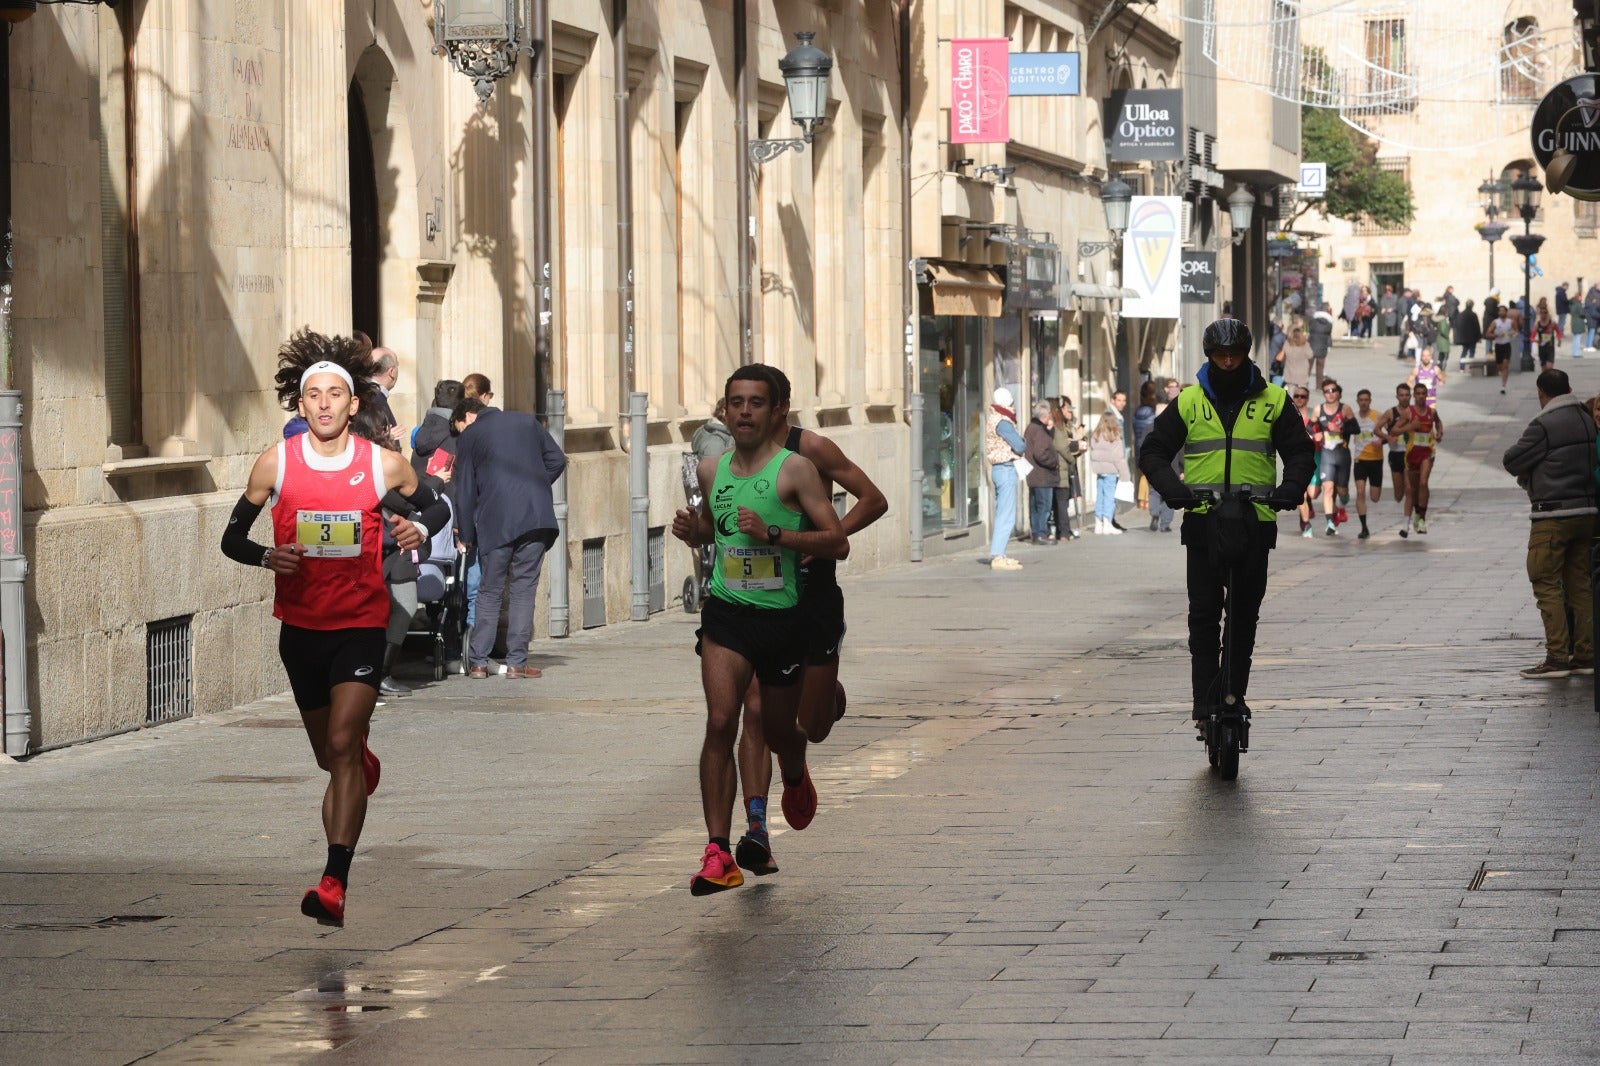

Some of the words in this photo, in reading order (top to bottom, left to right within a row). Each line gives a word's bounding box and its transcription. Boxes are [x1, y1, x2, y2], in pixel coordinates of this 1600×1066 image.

[1010, 75, 1055, 83] UDITIVO
[1011, 67, 1055, 75] CENTRO
[1124, 104, 1170, 121] Ulloa
[1119, 121, 1175, 142] Optico
[321, 524, 330, 541] 3
[743, 558, 752, 576] 5
